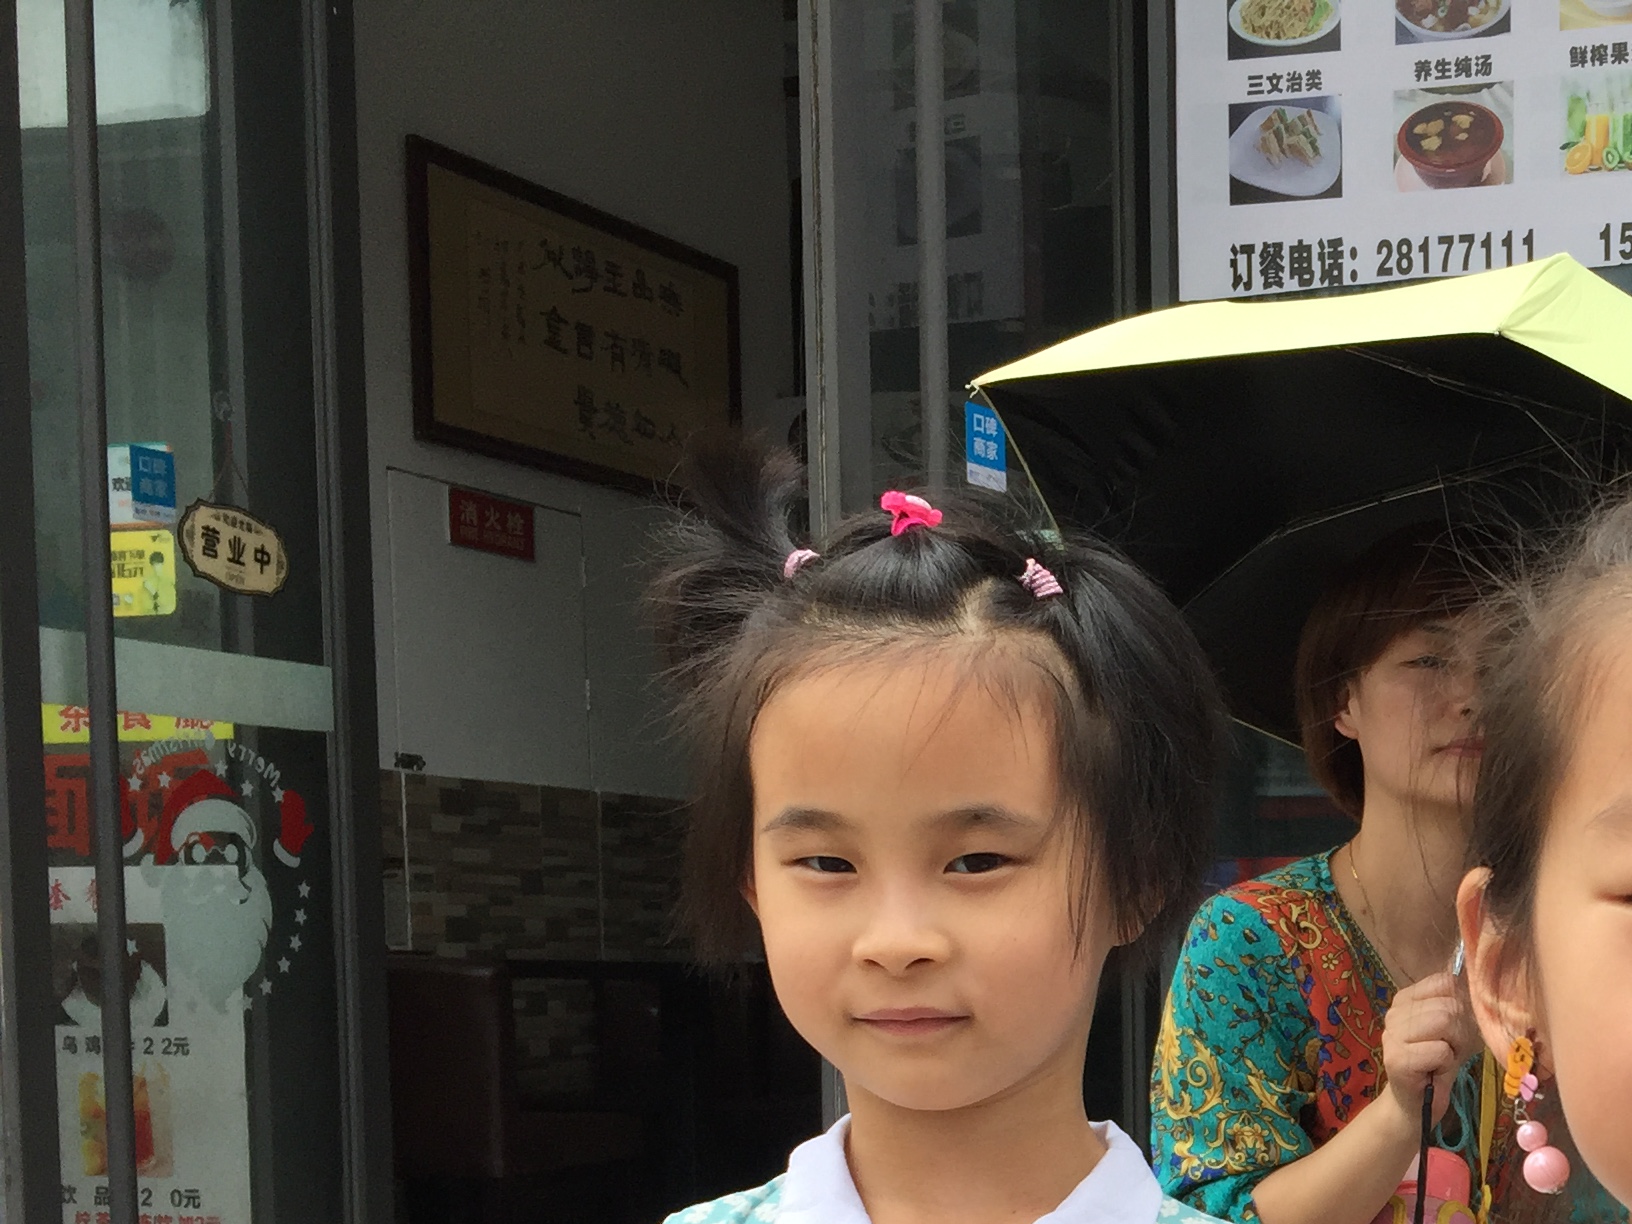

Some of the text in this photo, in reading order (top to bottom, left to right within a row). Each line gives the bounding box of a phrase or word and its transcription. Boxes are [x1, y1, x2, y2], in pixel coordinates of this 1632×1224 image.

[1246, 68, 1324, 96] 三文治类
[1376, 228, 1536, 278] 28177111
[973, 436, 998, 460] 商家
[201, 524, 271, 575] 营业中
